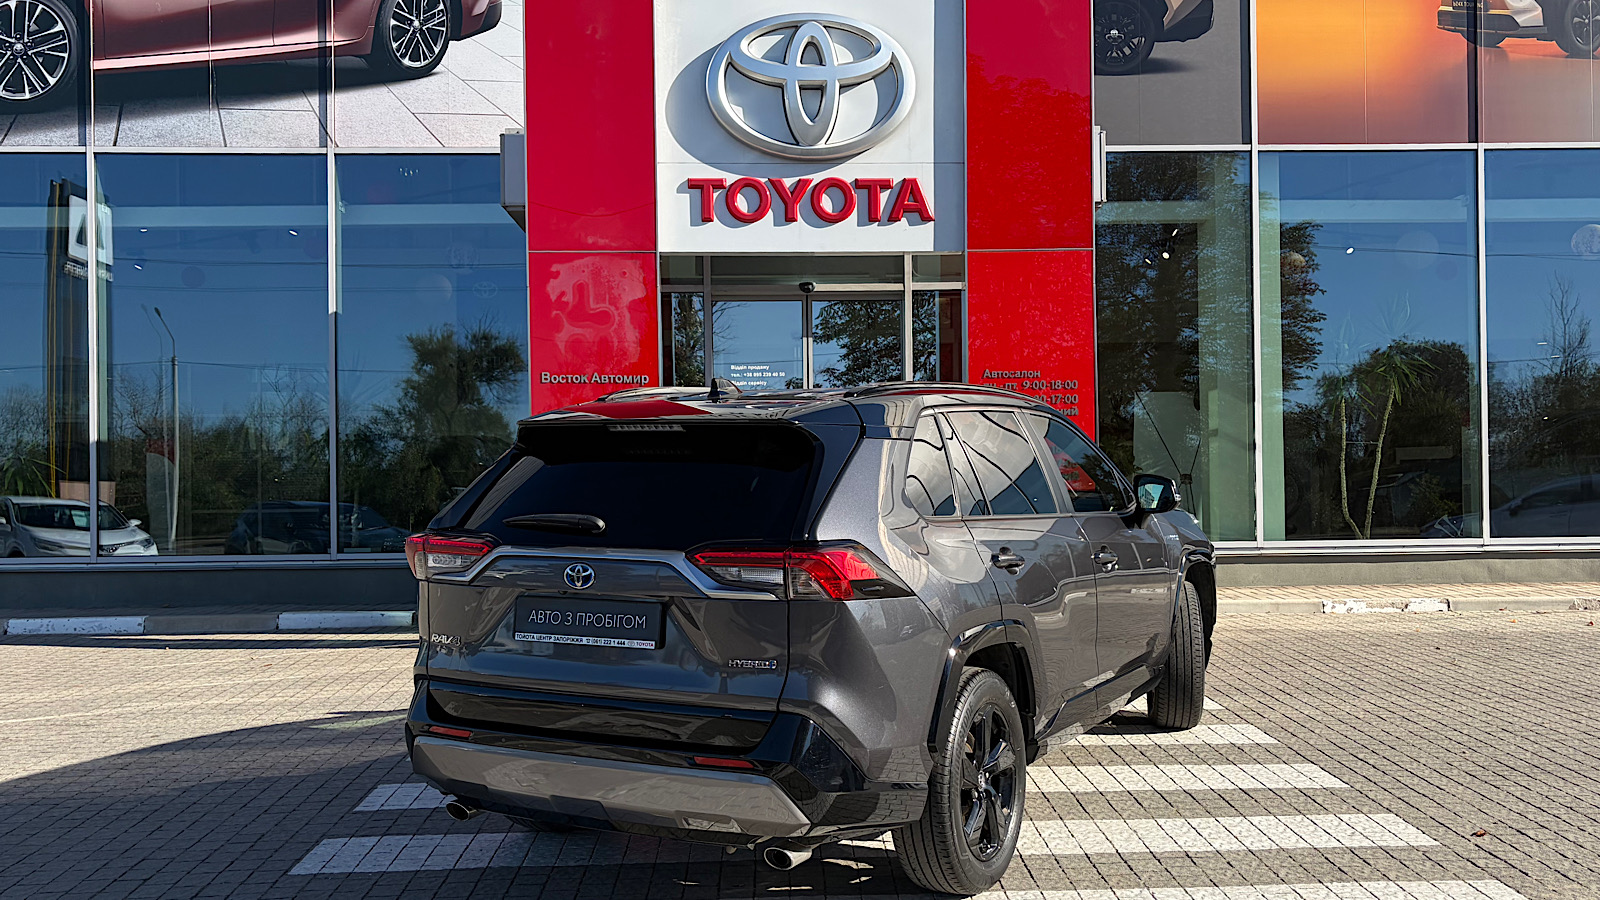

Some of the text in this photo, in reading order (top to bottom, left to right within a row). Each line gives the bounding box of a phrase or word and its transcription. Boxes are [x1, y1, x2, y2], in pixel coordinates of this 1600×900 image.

[688, 176, 935, 223] TOYOTA
[541, 371, 649, 386] Восток Автомир
[983, 369, 1041, 378] Автосалон
[1023, 380, 1079, 390] 9:00-18:00
[528, 609, 646, 629] АВТО З ПРОБІГОМ
[432, 634, 460, 646] RAV4
[728, 659, 770, 669] HYBRID
